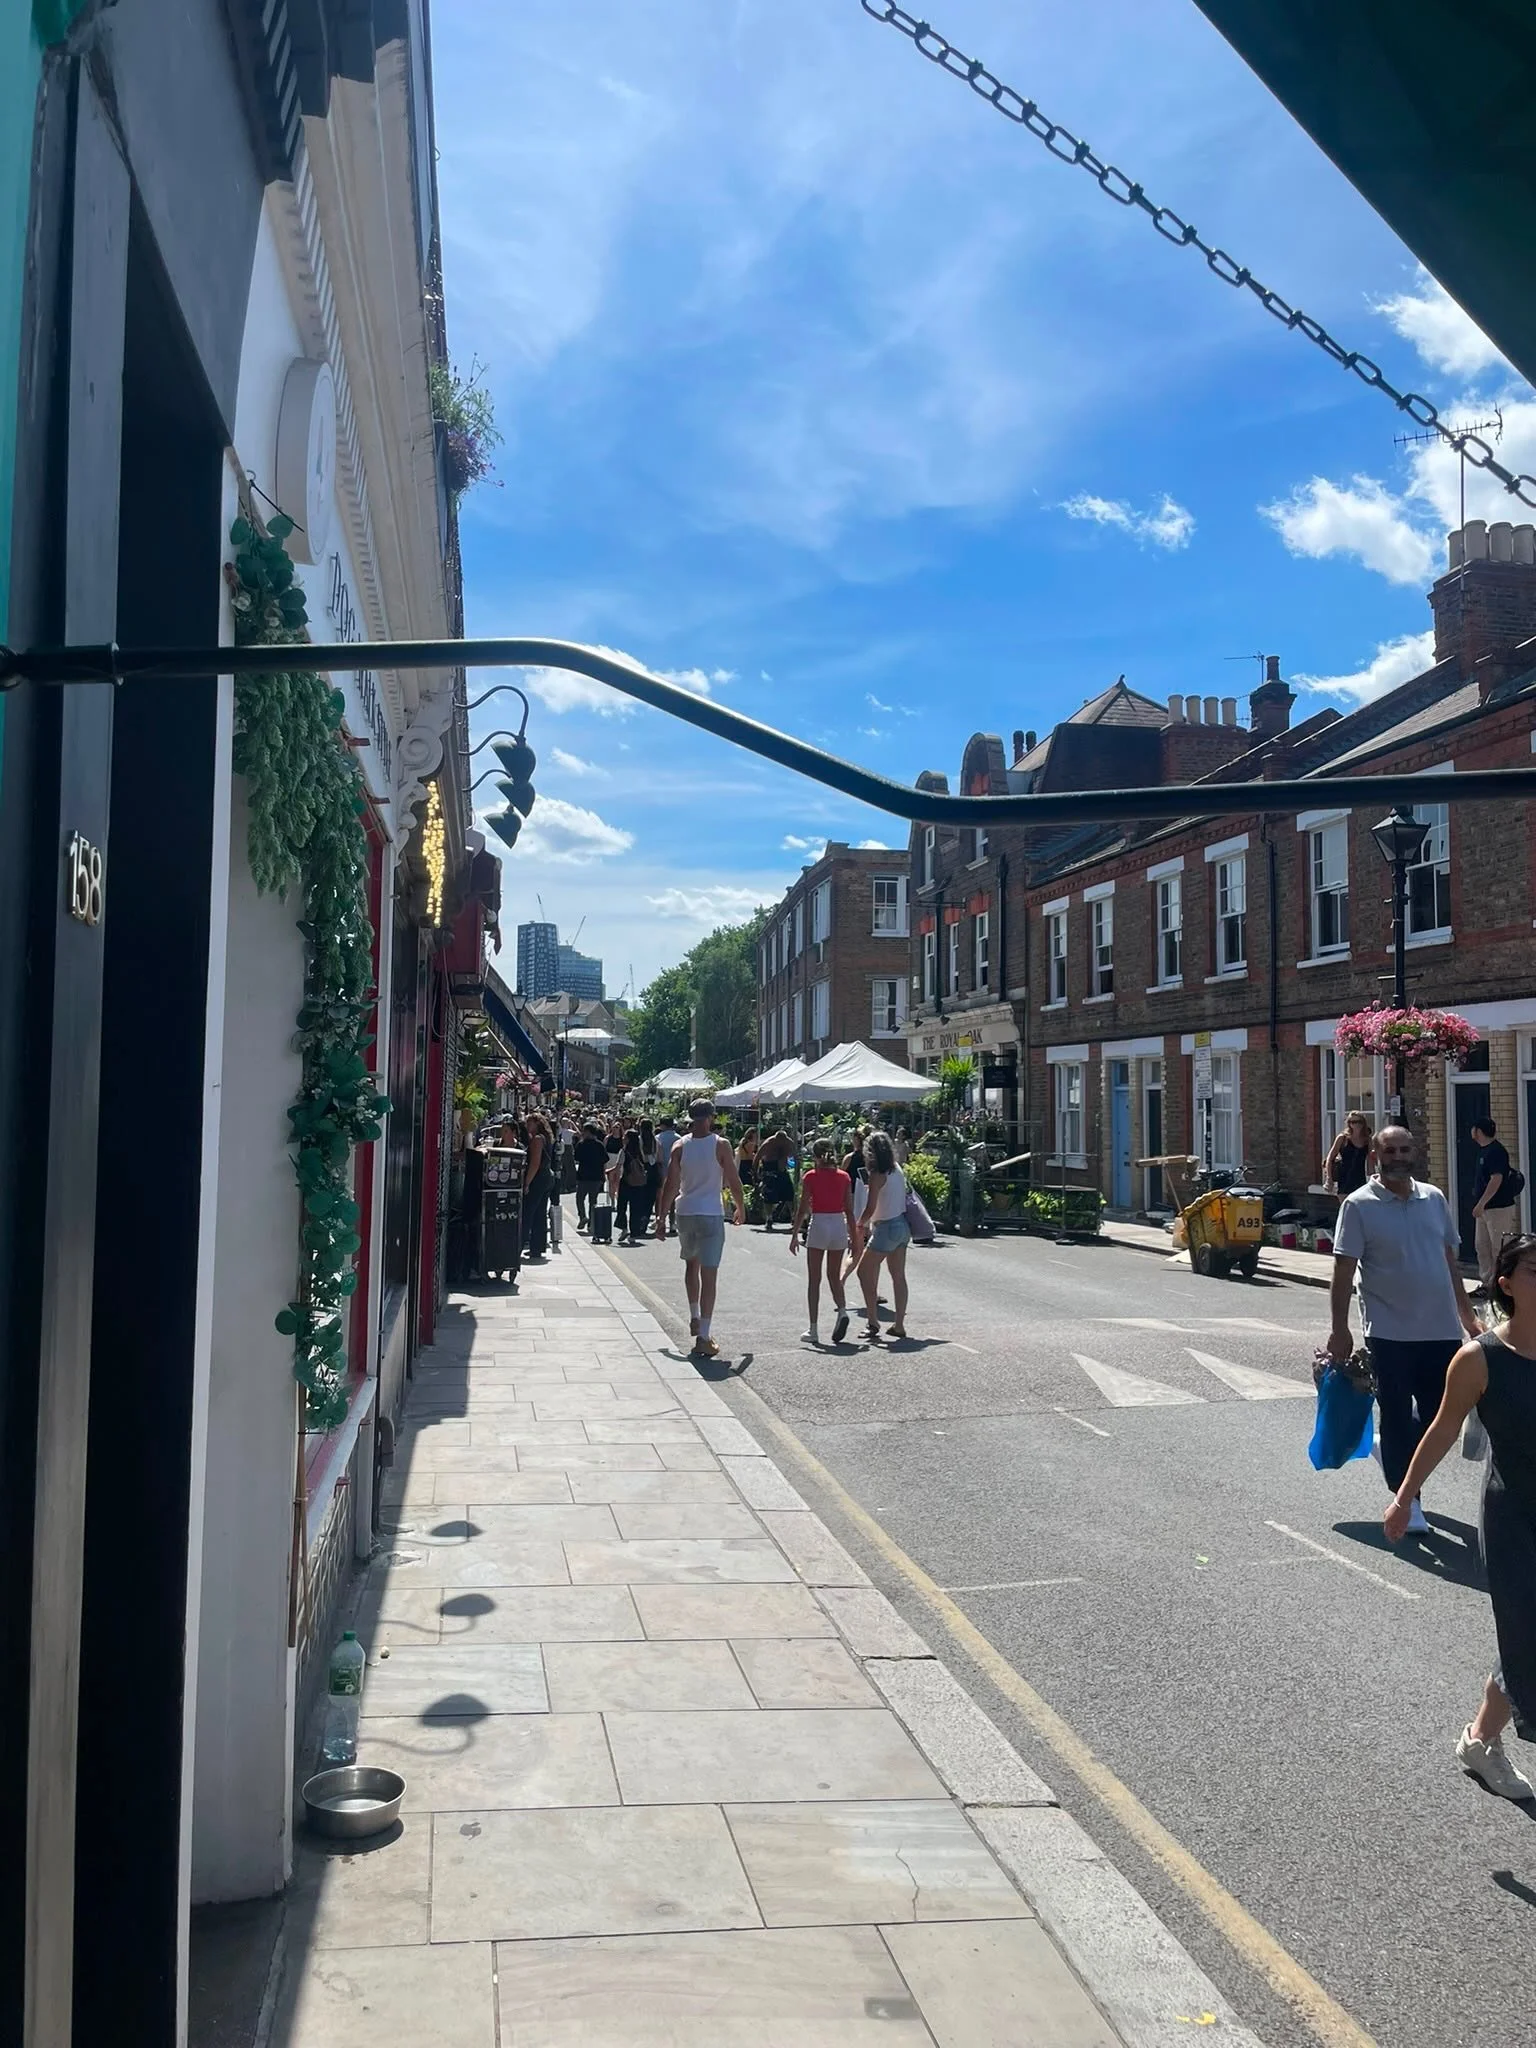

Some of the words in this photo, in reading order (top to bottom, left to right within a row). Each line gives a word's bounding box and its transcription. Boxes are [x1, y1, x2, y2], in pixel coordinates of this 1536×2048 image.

[69, 829, 102, 926] 158
[922, 1036, 936, 1051] THE
[940, 1032, 961, 1049] ROYA
[1237, 1217, 1260, 1229] A93
